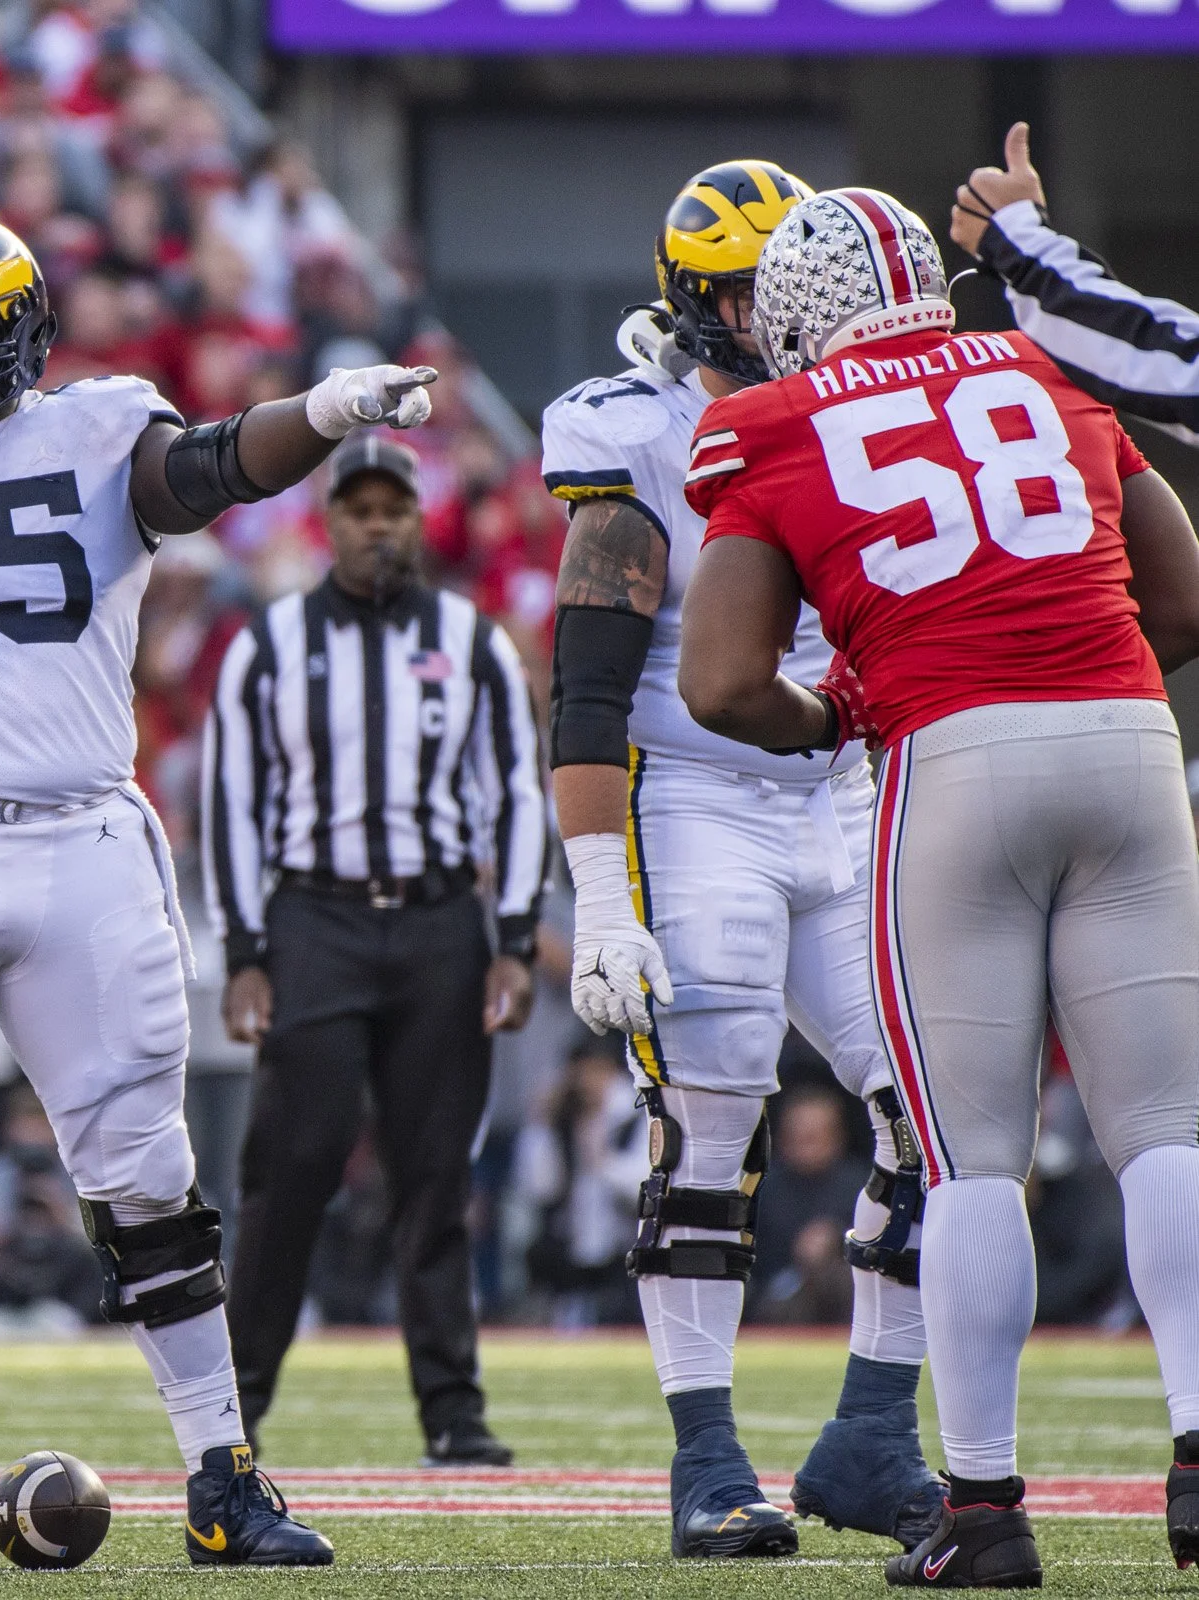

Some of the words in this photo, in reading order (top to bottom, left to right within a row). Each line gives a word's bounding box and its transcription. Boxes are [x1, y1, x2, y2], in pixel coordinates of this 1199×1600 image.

[853, 309, 952, 340] BUCKEYES
[807, 334, 1020, 399] HAMILTON
[809, 369, 1095, 597] 58
[420, 698, 446, 739] C
[235, 1452, 252, 1470] M
